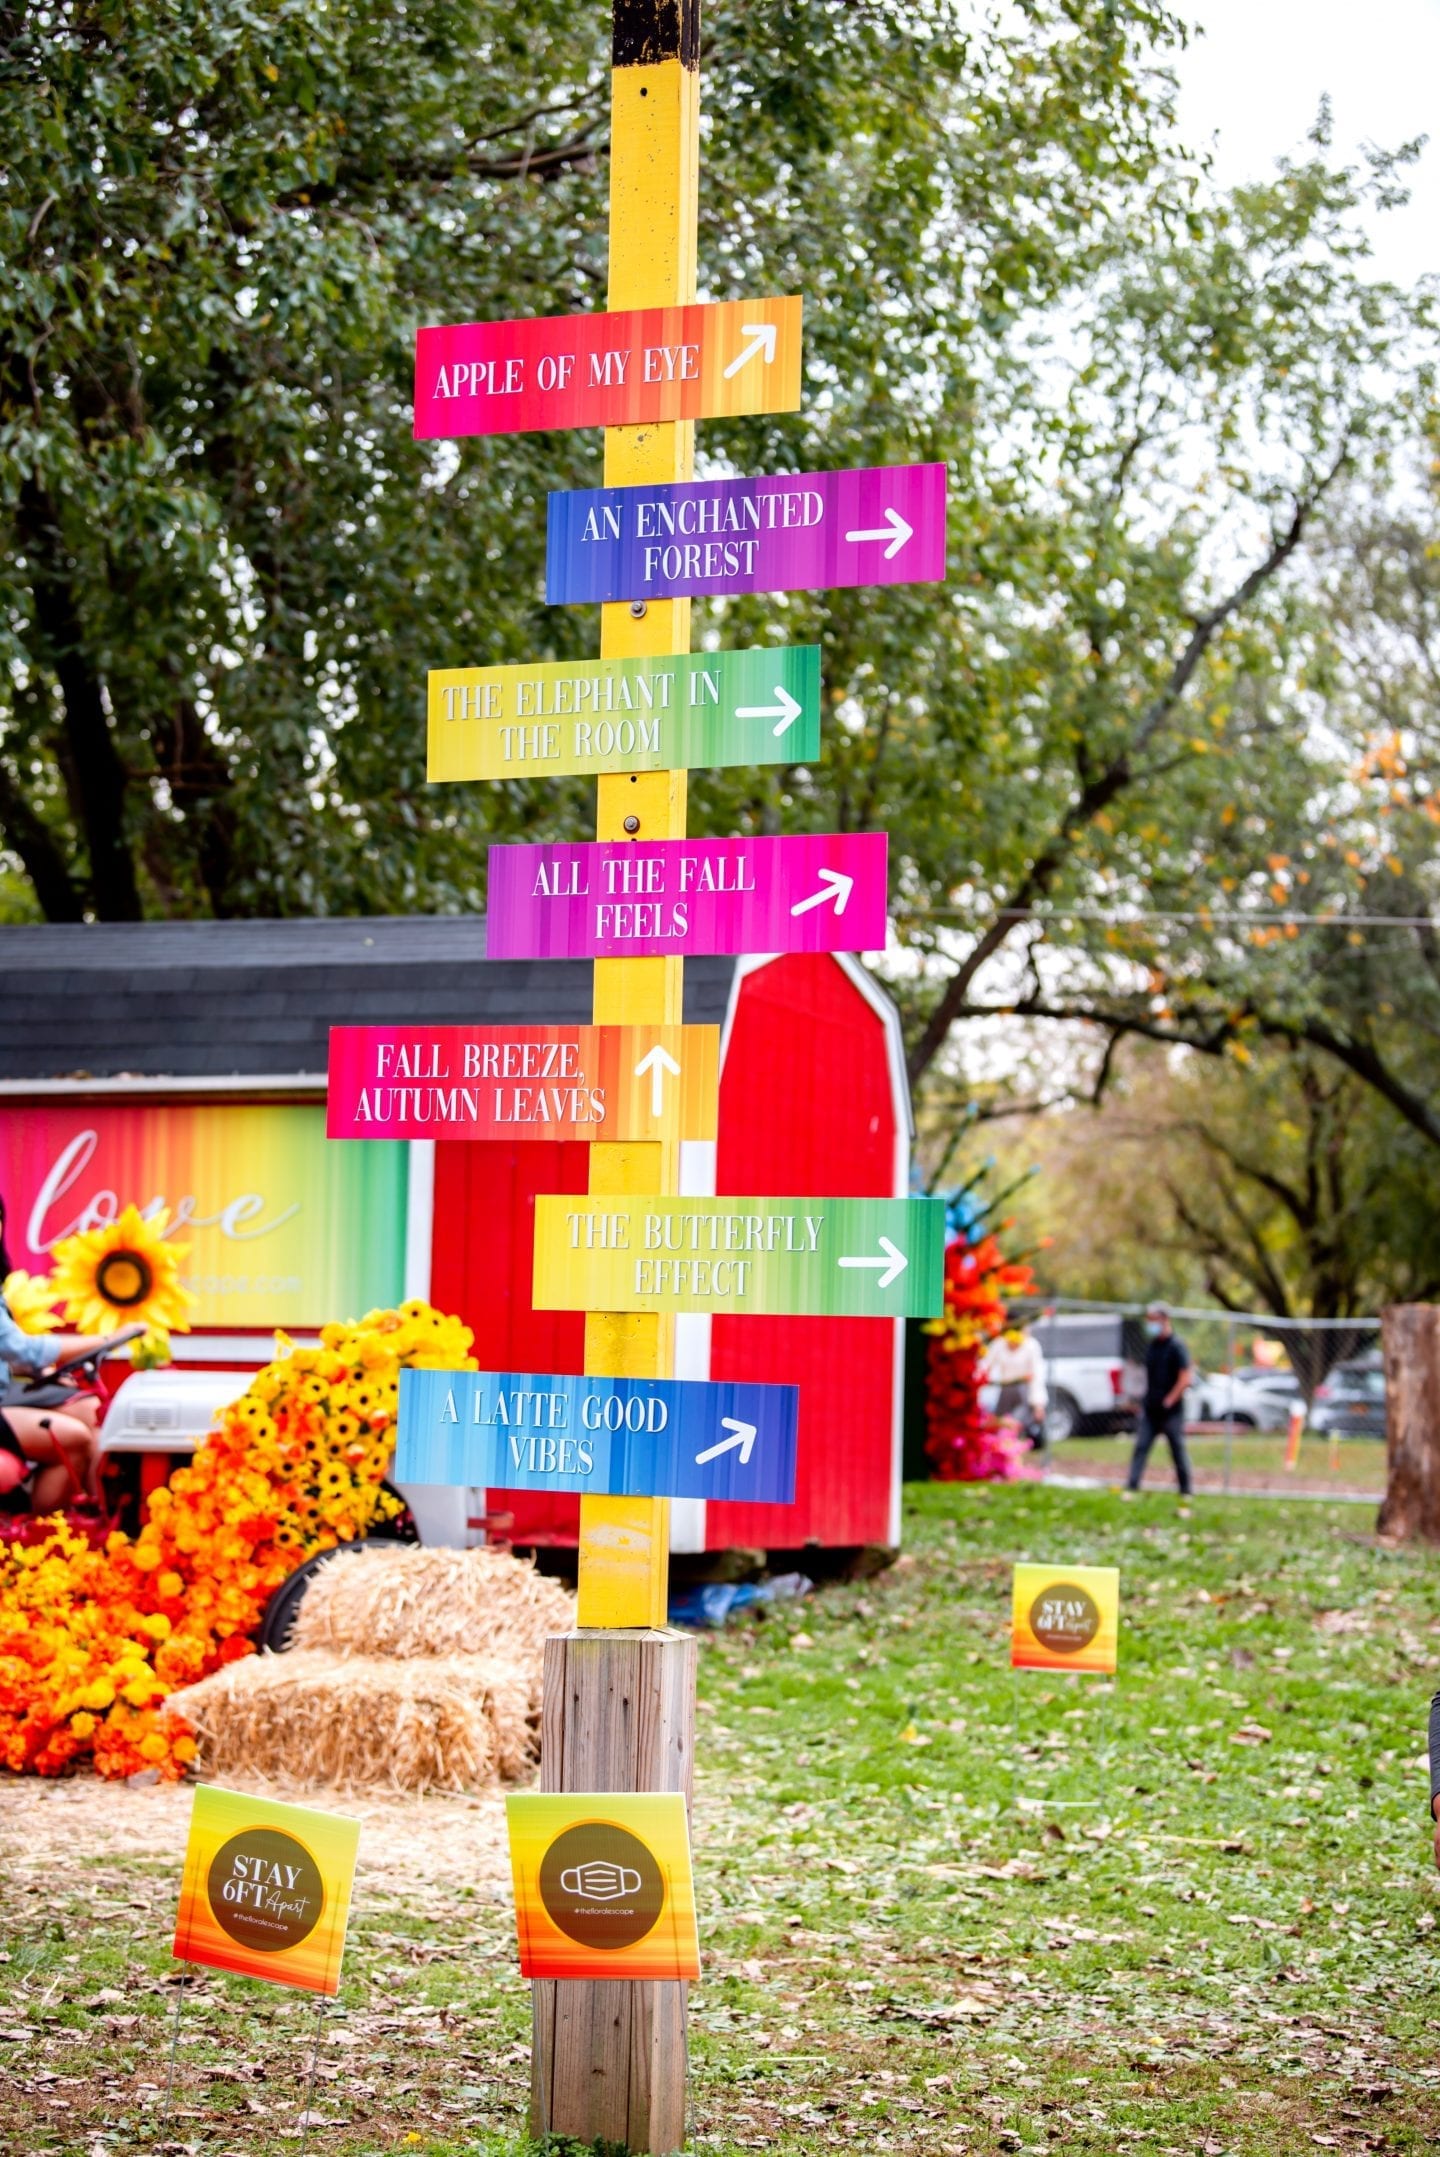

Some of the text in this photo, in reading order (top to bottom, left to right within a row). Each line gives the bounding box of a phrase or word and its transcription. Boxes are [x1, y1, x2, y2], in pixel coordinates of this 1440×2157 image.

[433, 345, 699, 399] APPLE OF MY EYE
[581, 491, 824, 543] AN ENCHANTED
[643, 540, 760, 582] FOREST
[441, 670, 722, 722] THE ELEPHANT IN
[500, 719, 661, 761] THE ROOM
[531, 856, 755, 897] ALL THE FALL
[594, 902, 688, 939] FEELS
[376, 1044, 585, 1084] FALL BREEZE,
[354, 1087, 606, 1123] AUTUMN LEAVES
[566, 1213, 825, 1252] THE BUTTERFLY
[634, 1259, 752, 1296] EFFECT
[440, 1389, 669, 1433] A LATTE GOOD
[508, 1436, 594, 1475] VIBES
[1042, 1600, 1086, 1617] STAY
[232, 1854, 303, 1890] STAY
[222, 1878, 310, 1920] 6FT Apart
